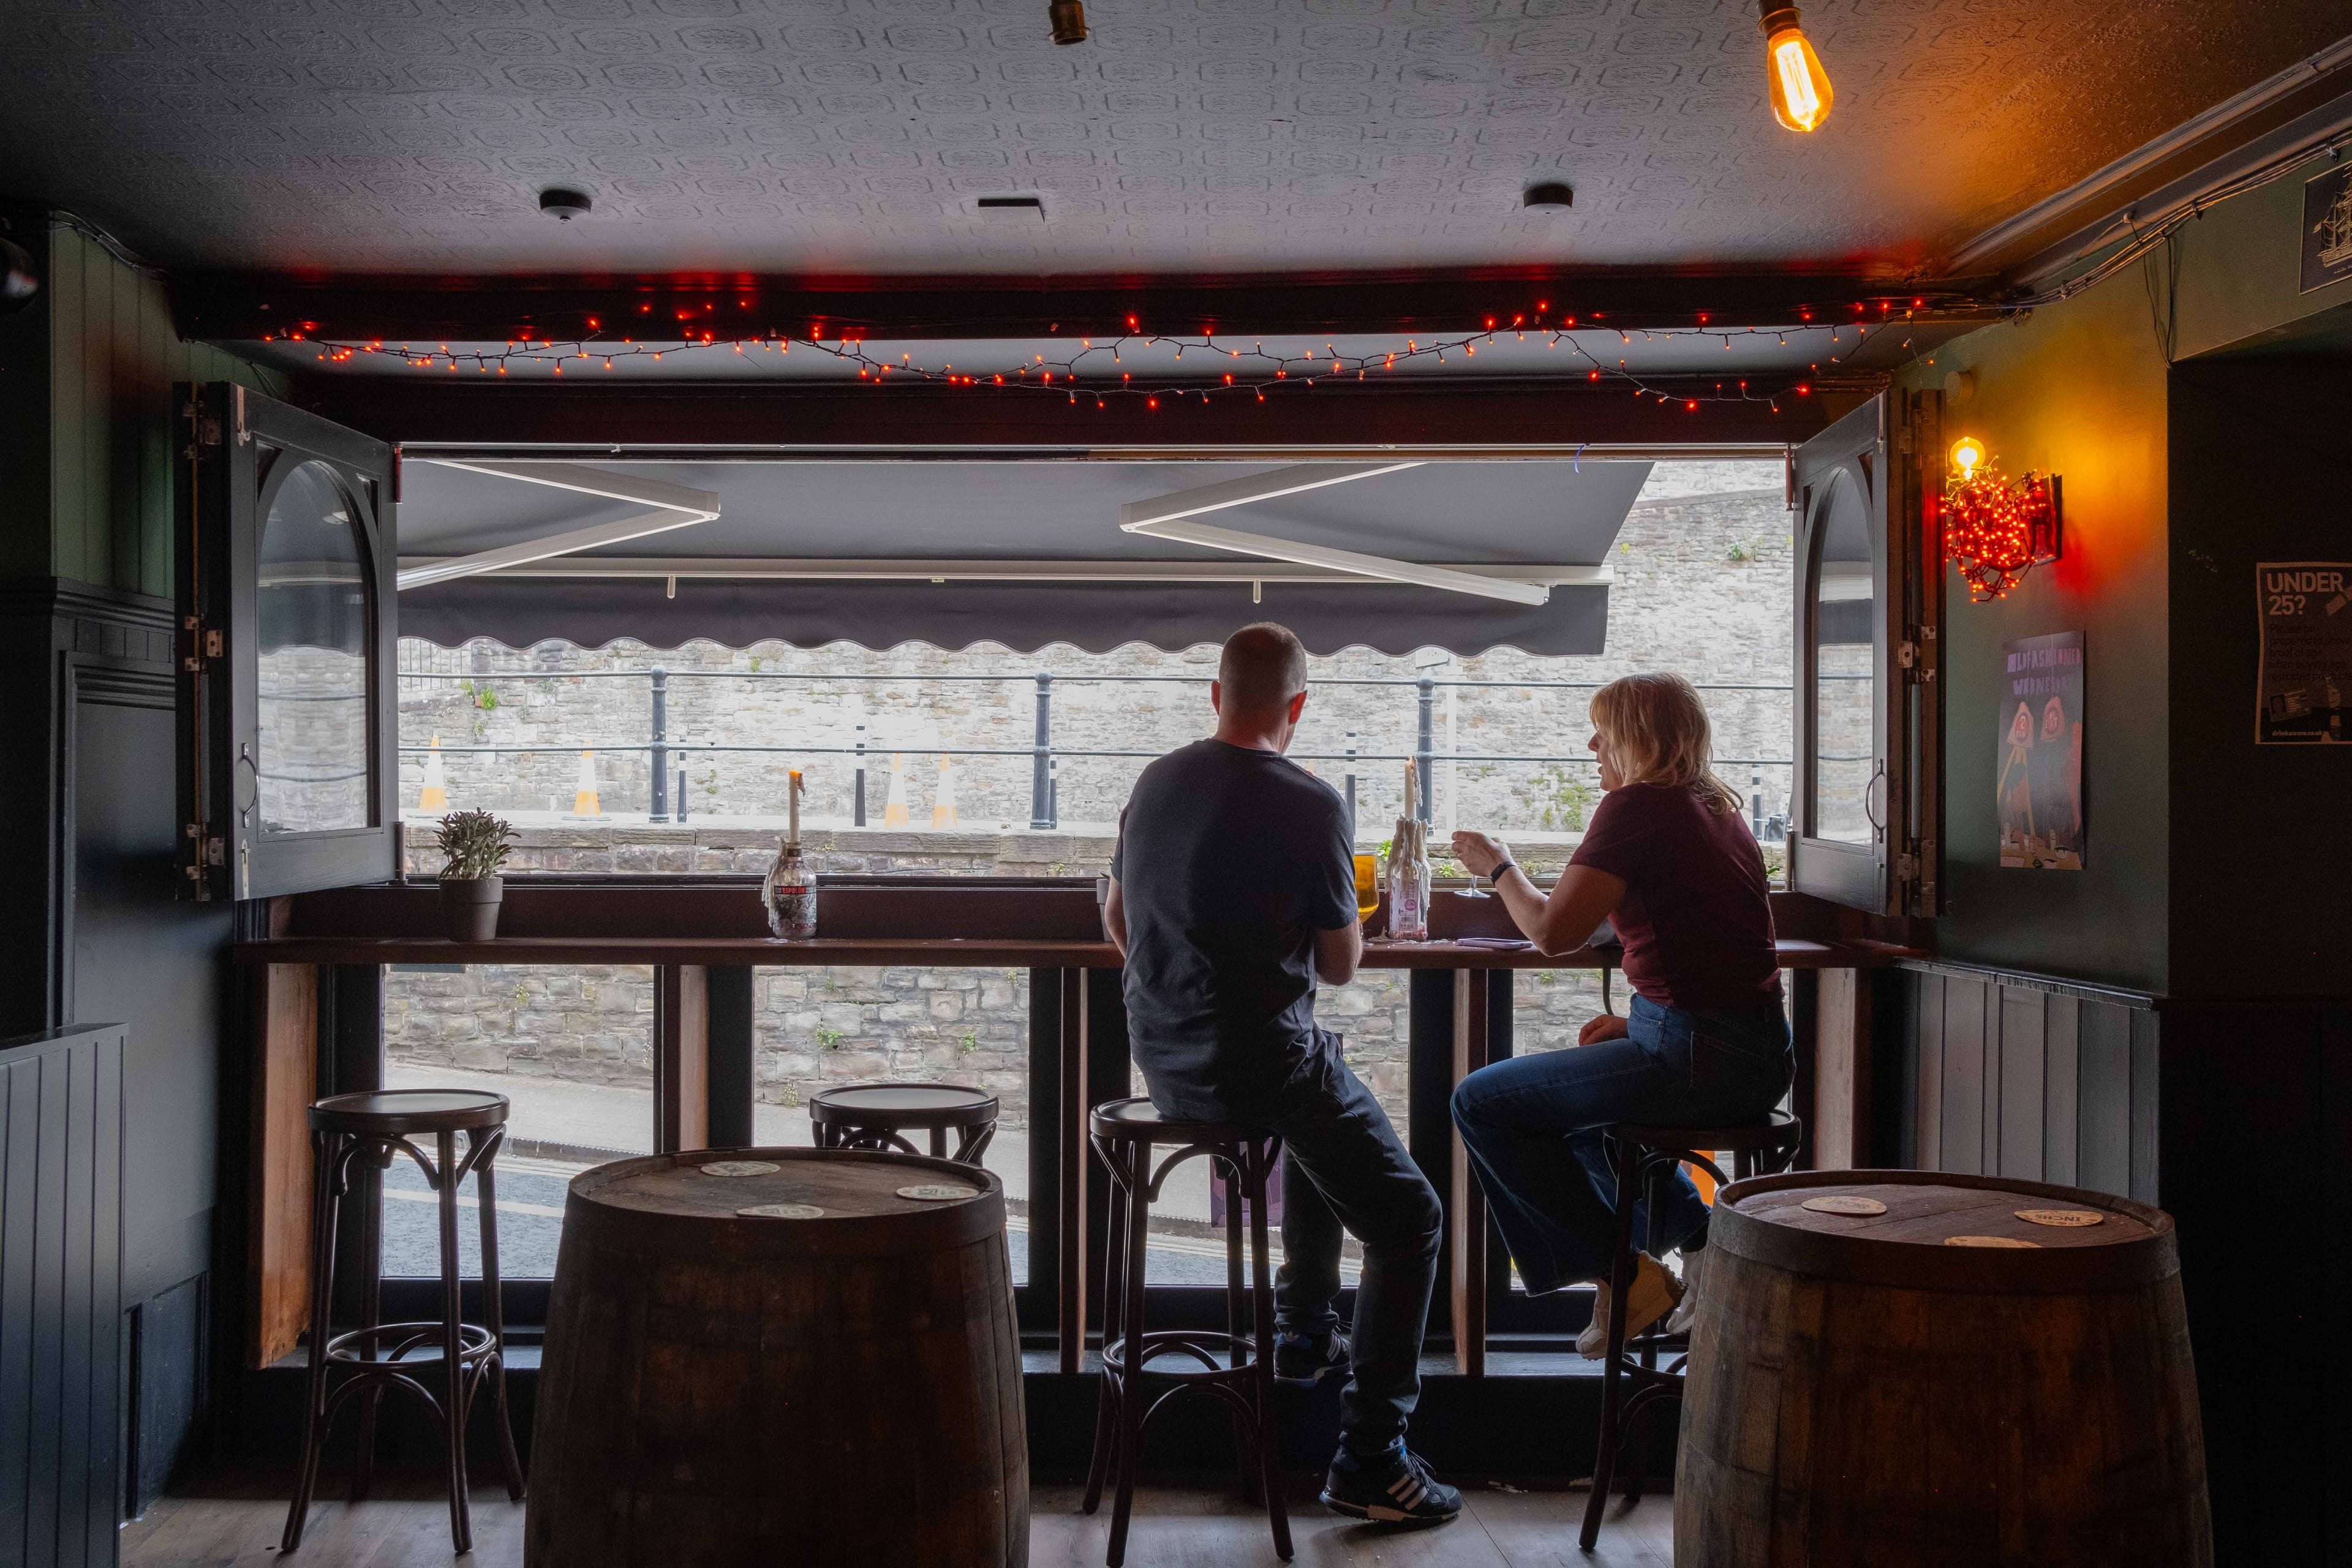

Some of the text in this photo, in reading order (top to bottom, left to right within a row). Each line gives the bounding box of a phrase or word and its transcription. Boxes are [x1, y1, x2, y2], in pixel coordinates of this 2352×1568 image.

[2266, 571, 2345, 593] UNDER
[2269, 595, 2306, 616] 25?
[2269, 624, 2301, 633] Please
[2269, 636, 2311, 648] prepared
